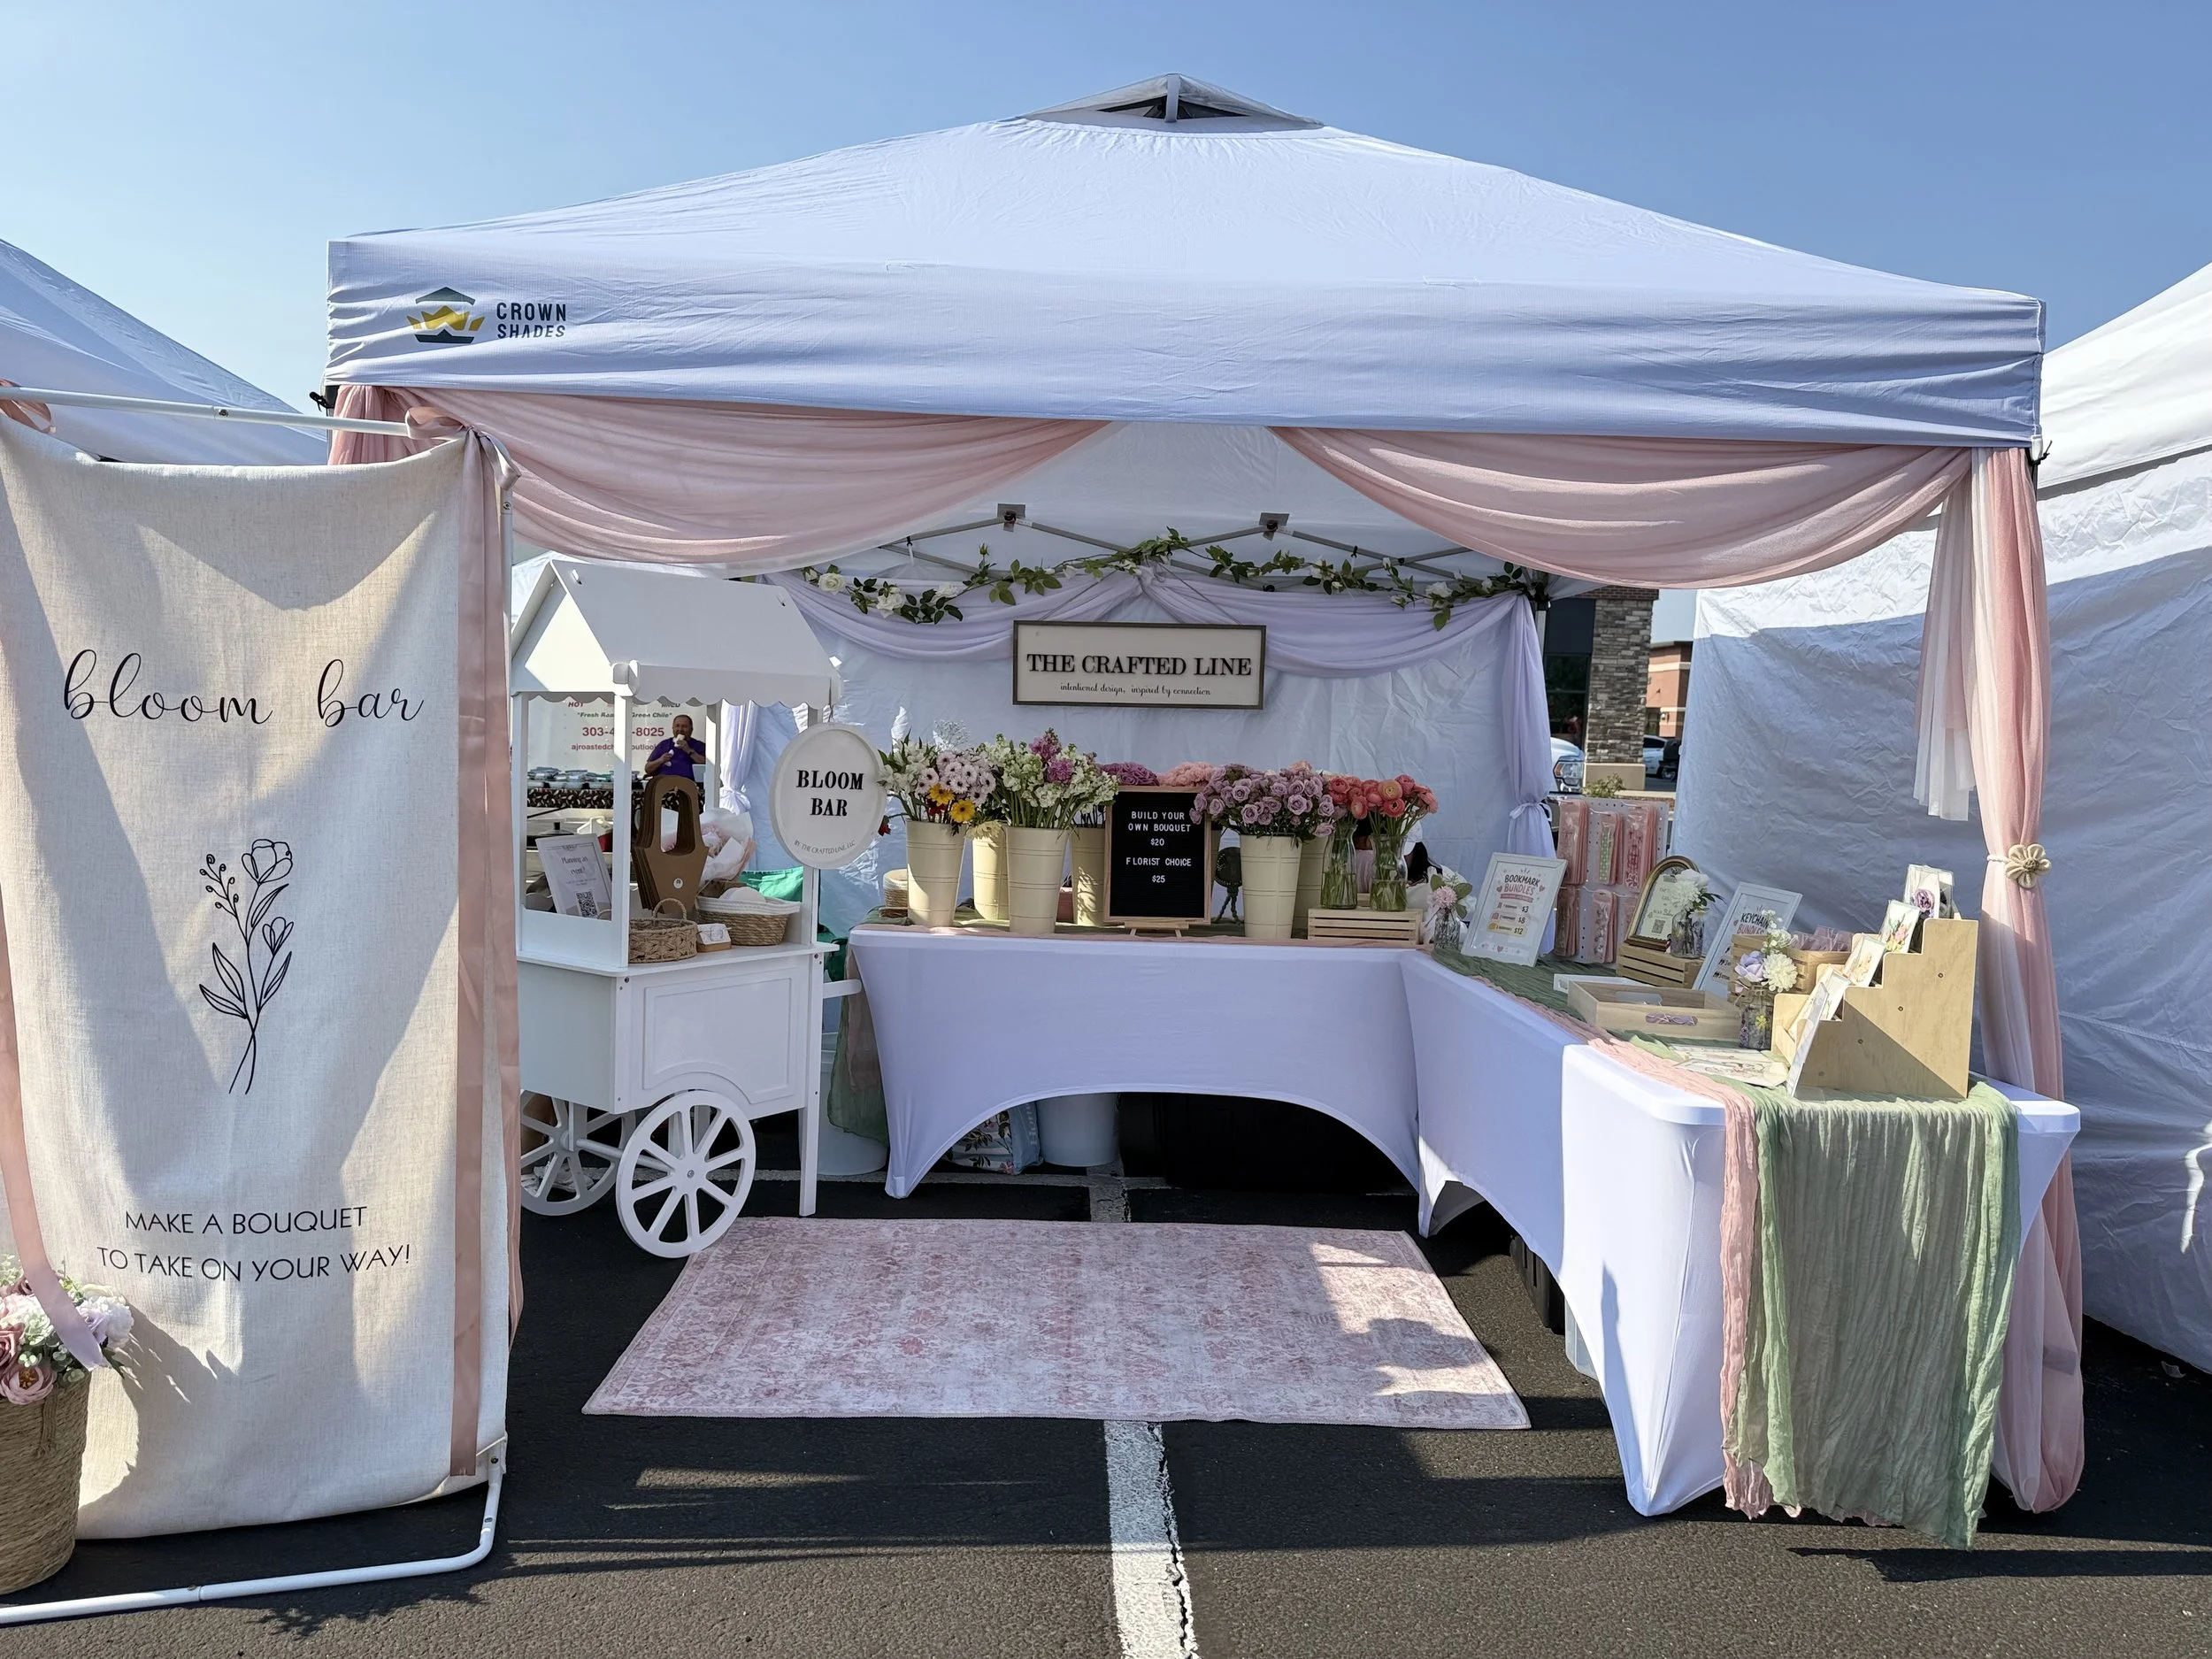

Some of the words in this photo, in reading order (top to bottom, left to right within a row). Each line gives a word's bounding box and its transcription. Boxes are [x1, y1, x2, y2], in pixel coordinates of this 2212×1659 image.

[496, 302, 566, 322] CROWN
[497, 323, 565, 339] SHADES
[1026, 653, 1075, 672] THE
[1081, 655, 1187, 675] CRAFTED
[1194, 657, 1252, 676] LINE
[64, 649, 273, 725] bloom
[317, 658, 425, 727] bar
[1060, 682, 1098, 692] intentional
[1131, 684, 1159, 697] inspired
[1162, 685, 1171, 697] by
[1172, 686, 1211, 695] connection
[795, 769, 864, 790] BLOOM
[810, 797, 848, 817] BAR
[1131, 811, 1158, 820] BUILD
[1162, 811, 1185, 820] YOUR
[1128, 823, 1148, 832] OWN
[1154, 823, 1192, 832] BOUQUET
[1504, 874, 1540, 887] BOOKMARK
[1504, 883, 1535, 896] BUNDLES
[1740, 912, 1769, 929] KEYCHAIN
[1514, 926, 1524, 935] $12
[126, 1210, 195, 1234] MAKE
[202, 1213, 224, 1235] A
[233, 1206, 368, 1235] BOUQUET
[96, 1246, 128, 1270] TO
[134, 1253, 193, 1279] TAKE
[201, 1257, 241, 1282] ON
[251, 1256, 330, 1282] YOUR
[340, 1243, 411, 1274] WAY!
